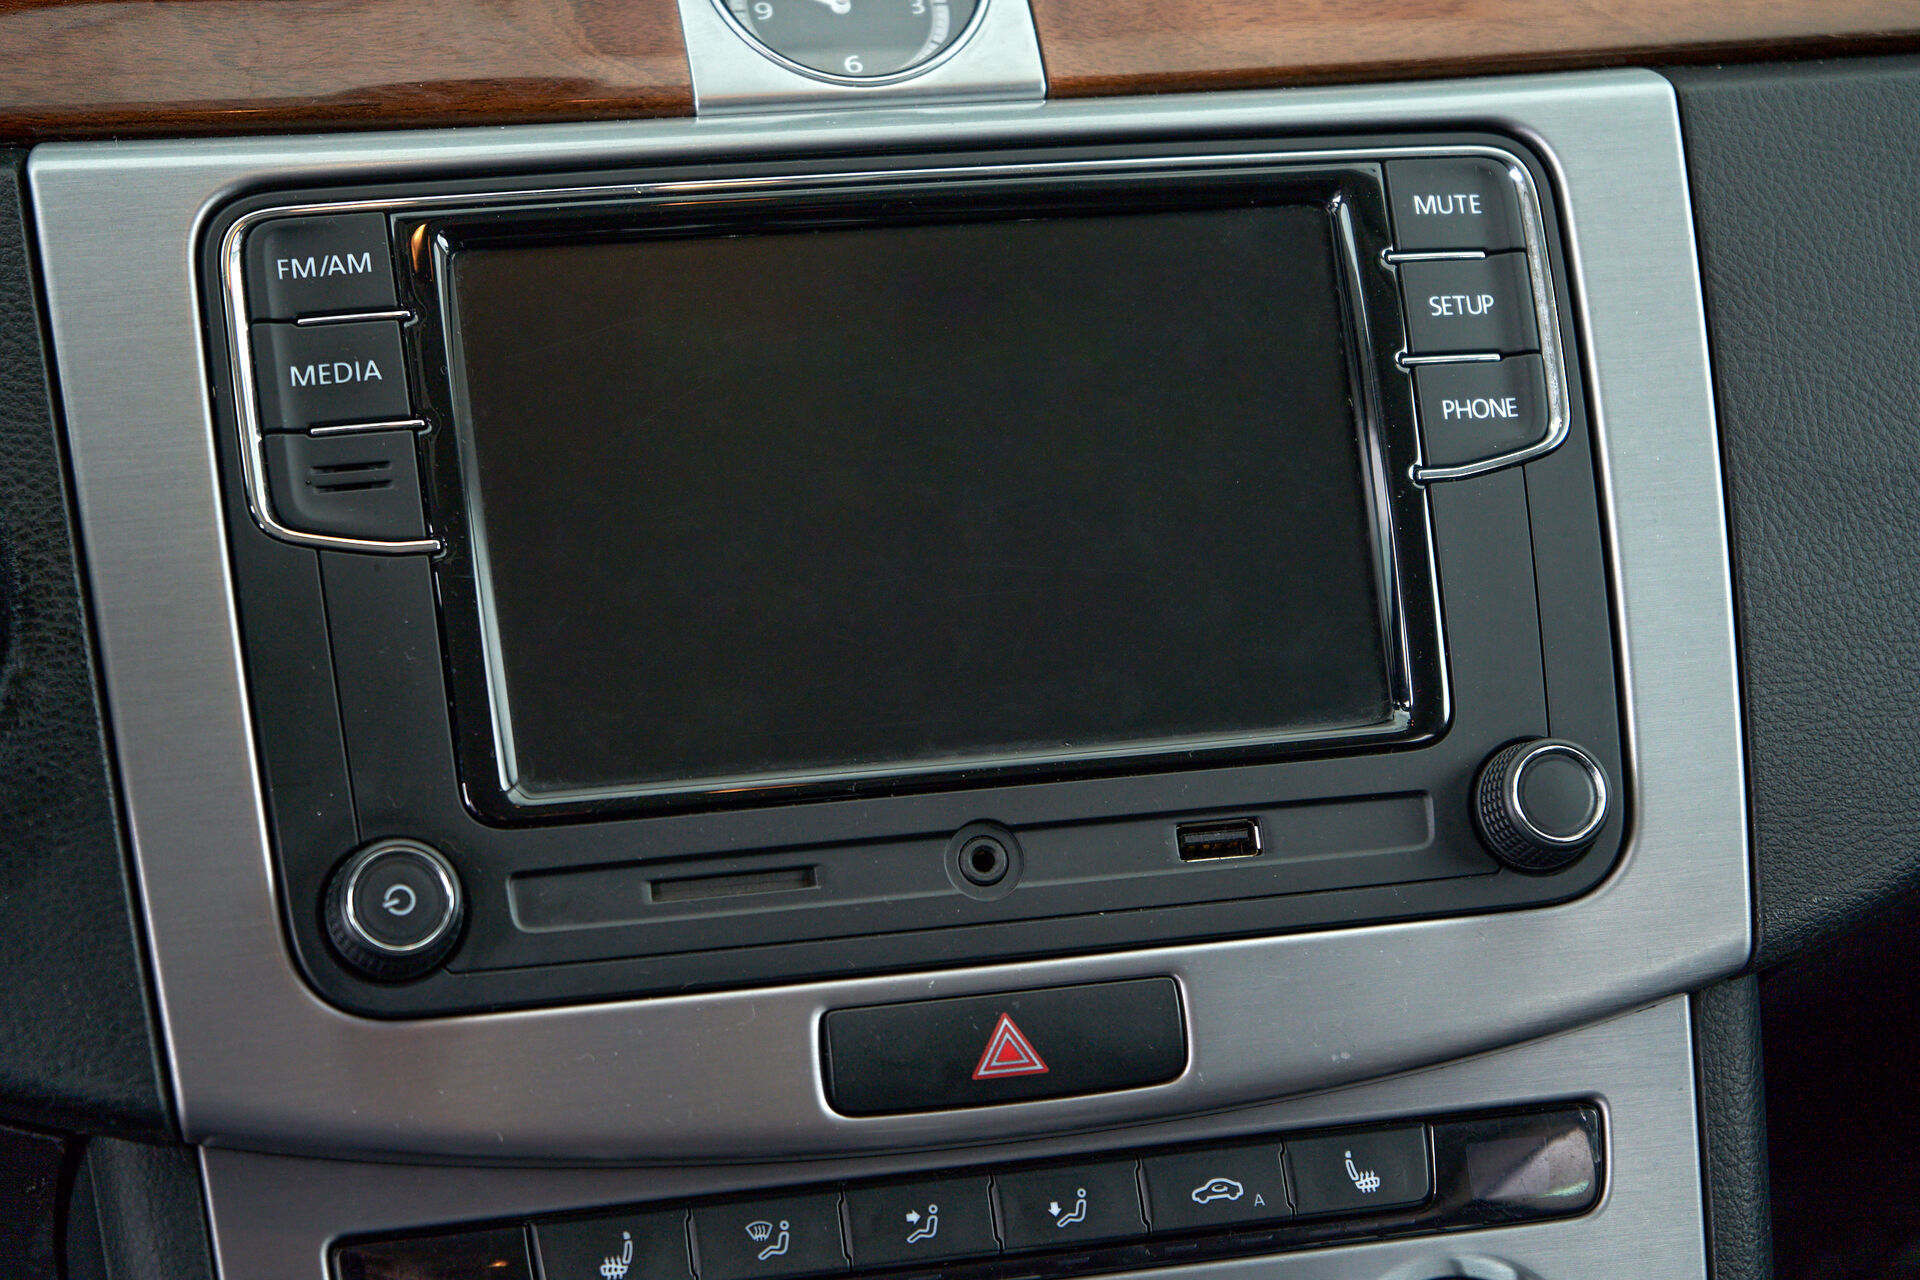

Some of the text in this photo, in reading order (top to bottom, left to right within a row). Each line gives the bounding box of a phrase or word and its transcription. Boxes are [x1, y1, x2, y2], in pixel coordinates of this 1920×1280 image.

[754, 3, 774, 20] 9
[911, 0, 926, 15] 3
[844, 55, 863, 74] 6
[1413, 194, 1483, 215] MUTE
[277, 252, 373, 280] FM/AM
[1428, 294, 1495, 317] SETUP
[290, 360, 383, 387] MEDIA
[1441, 398, 1519, 420] PHONE
[1253, 1193, 1266, 1208] A
